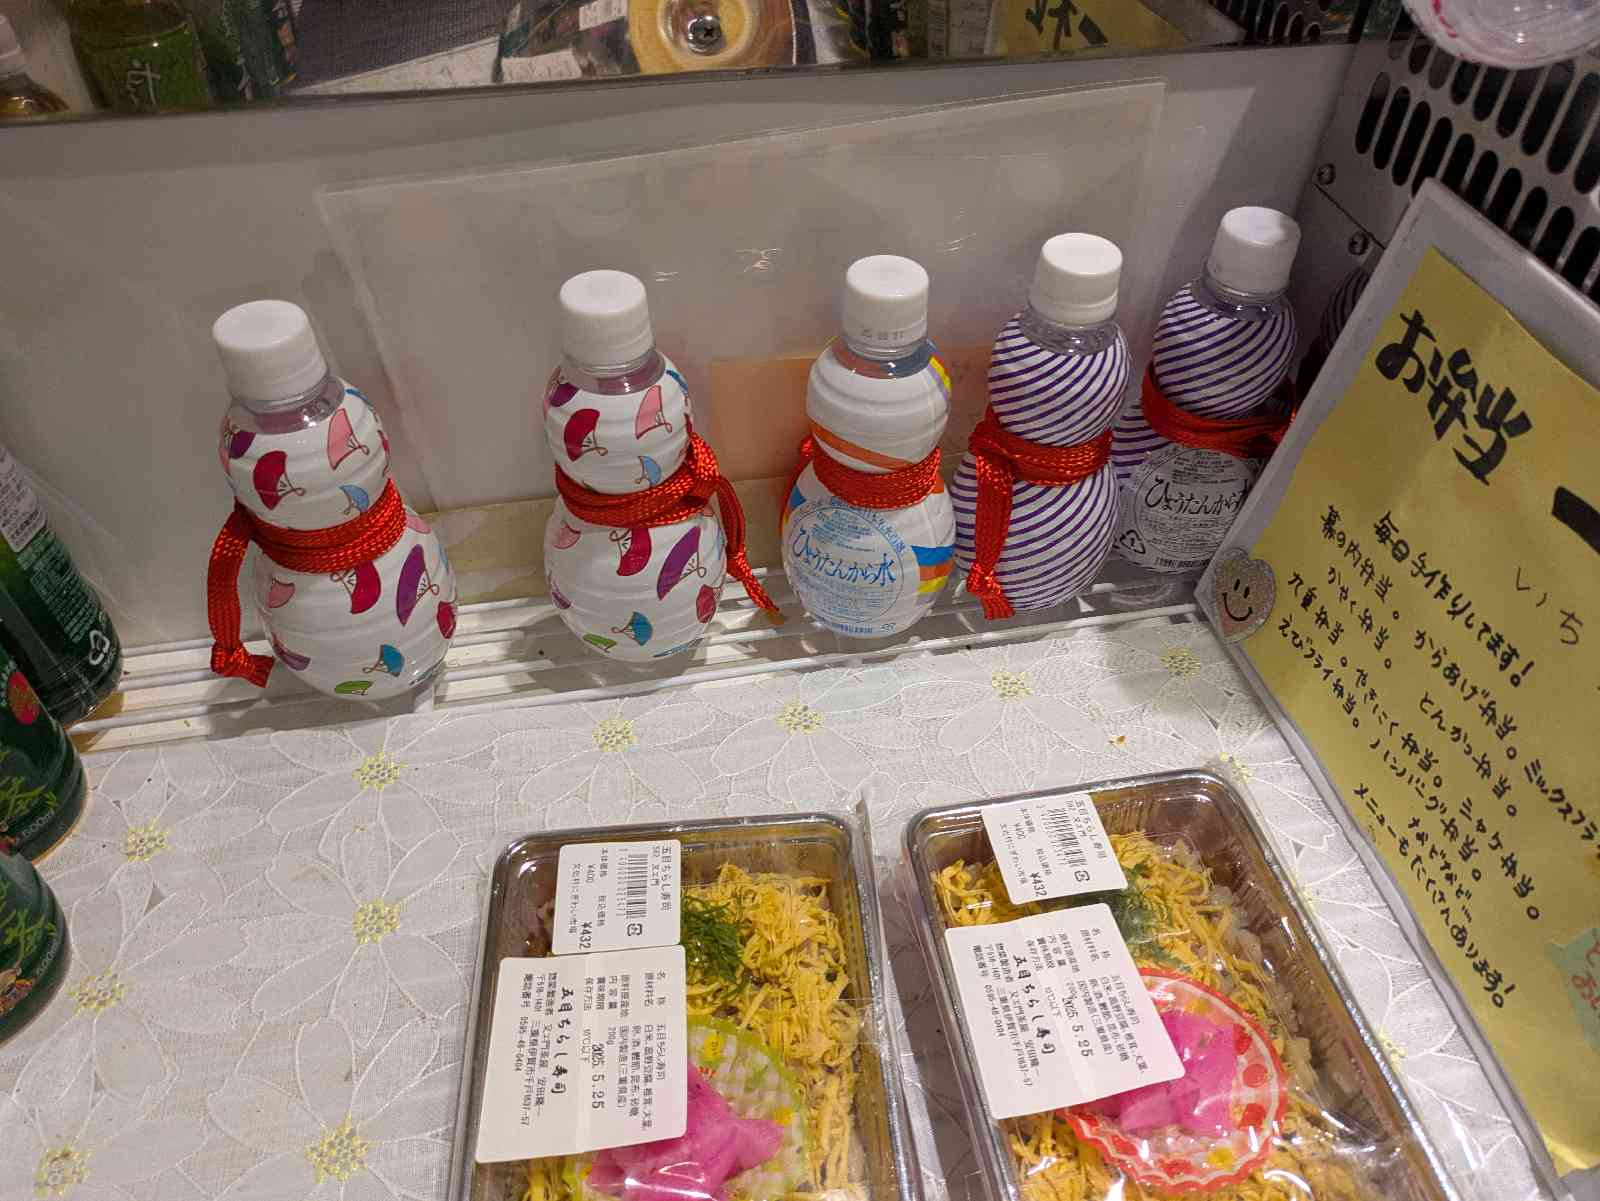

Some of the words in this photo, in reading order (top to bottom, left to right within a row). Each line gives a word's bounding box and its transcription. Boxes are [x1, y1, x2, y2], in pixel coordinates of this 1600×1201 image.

[1374, 308, 1536, 486] お弁当
[792, 527, 896, 587] ひょうたんから水
[1278, 614, 1365, 728] えびフライ弁当。
[1321, 505, 1399, 620] 幕の内弁当。
[1414, 630, 1518, 760] からあげ弁当。
[1328, 567, 1392, 669] かやく弁当。
[1420, 691, 1517, 817] とんかつ弁当。
[578, 921, 592, 949] ¥432
[1028, 870, 1048, 898] ¥432
[550, 986, 574, 1095] 五目ちらし寿司
[1011, 952, 1057, 1056] 五目ちらし寿司
